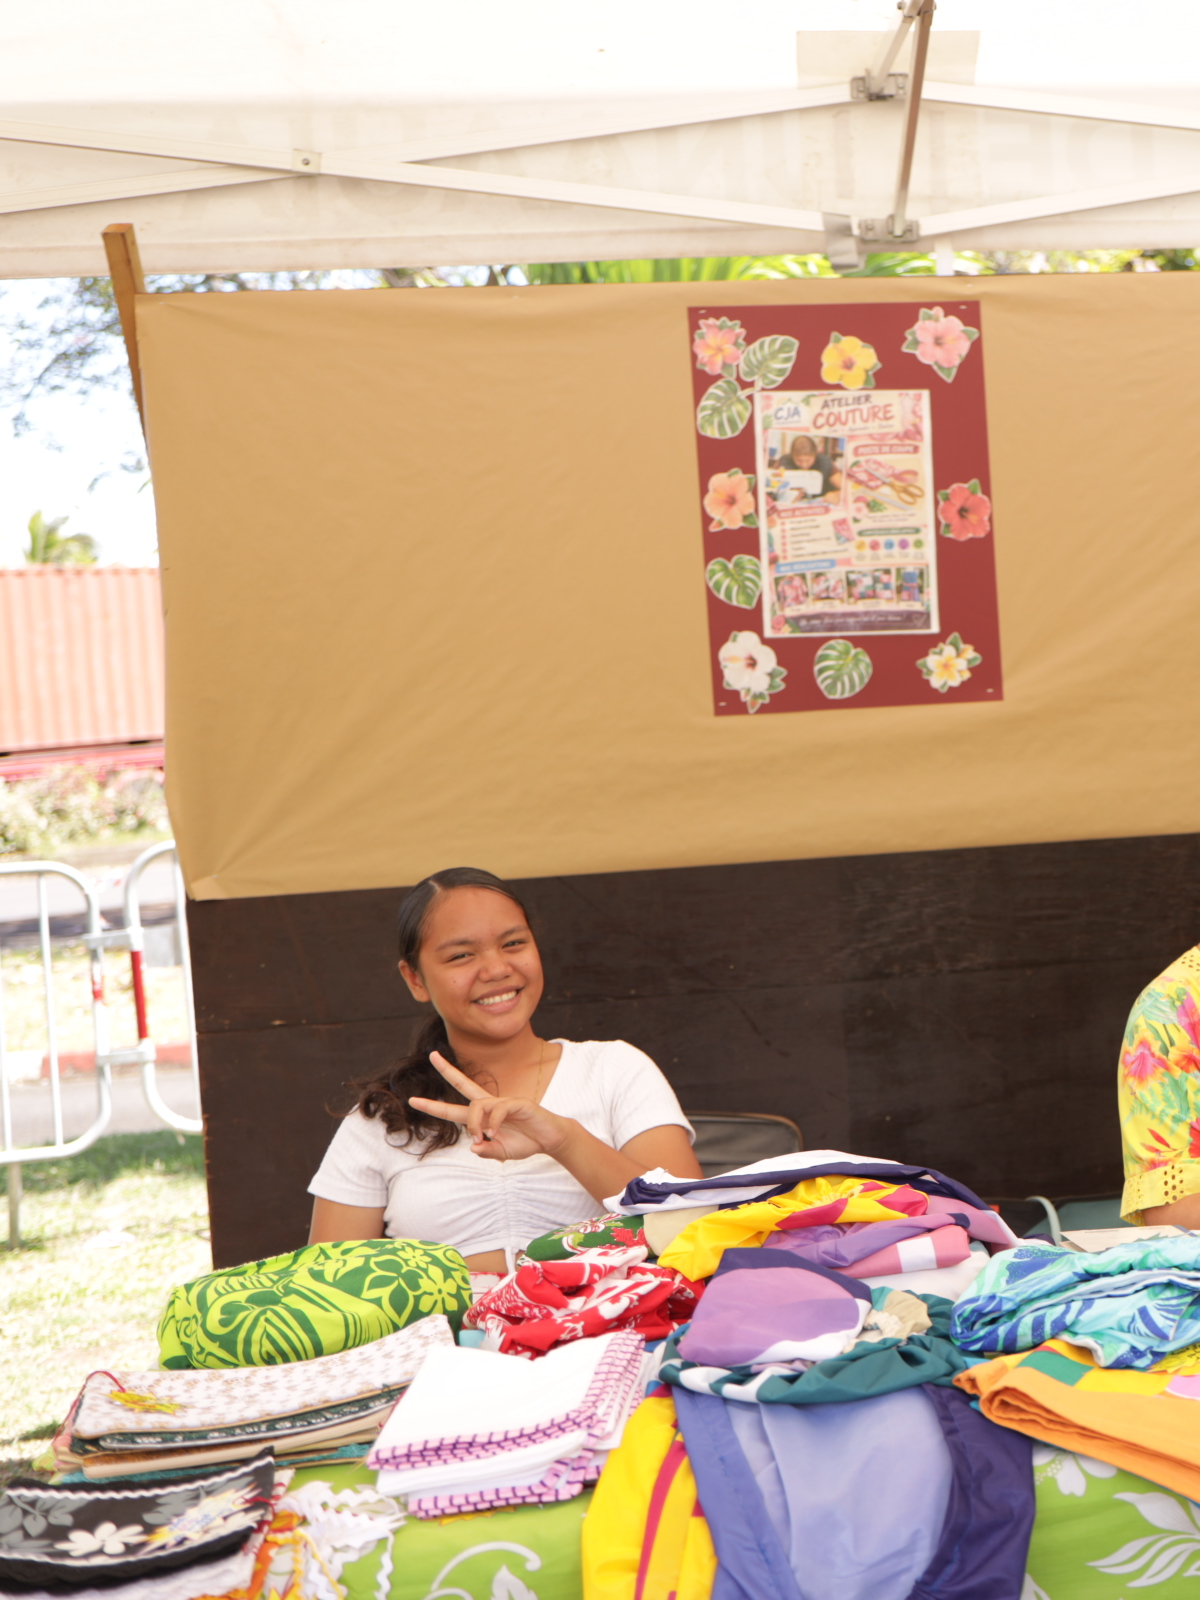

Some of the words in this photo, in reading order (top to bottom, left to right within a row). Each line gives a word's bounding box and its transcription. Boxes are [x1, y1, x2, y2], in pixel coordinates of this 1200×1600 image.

[821, 394, 873, 411] ATELIER
[774, 406, 801, 421] CJA
[812, 403, 895, 430] COUTURE
